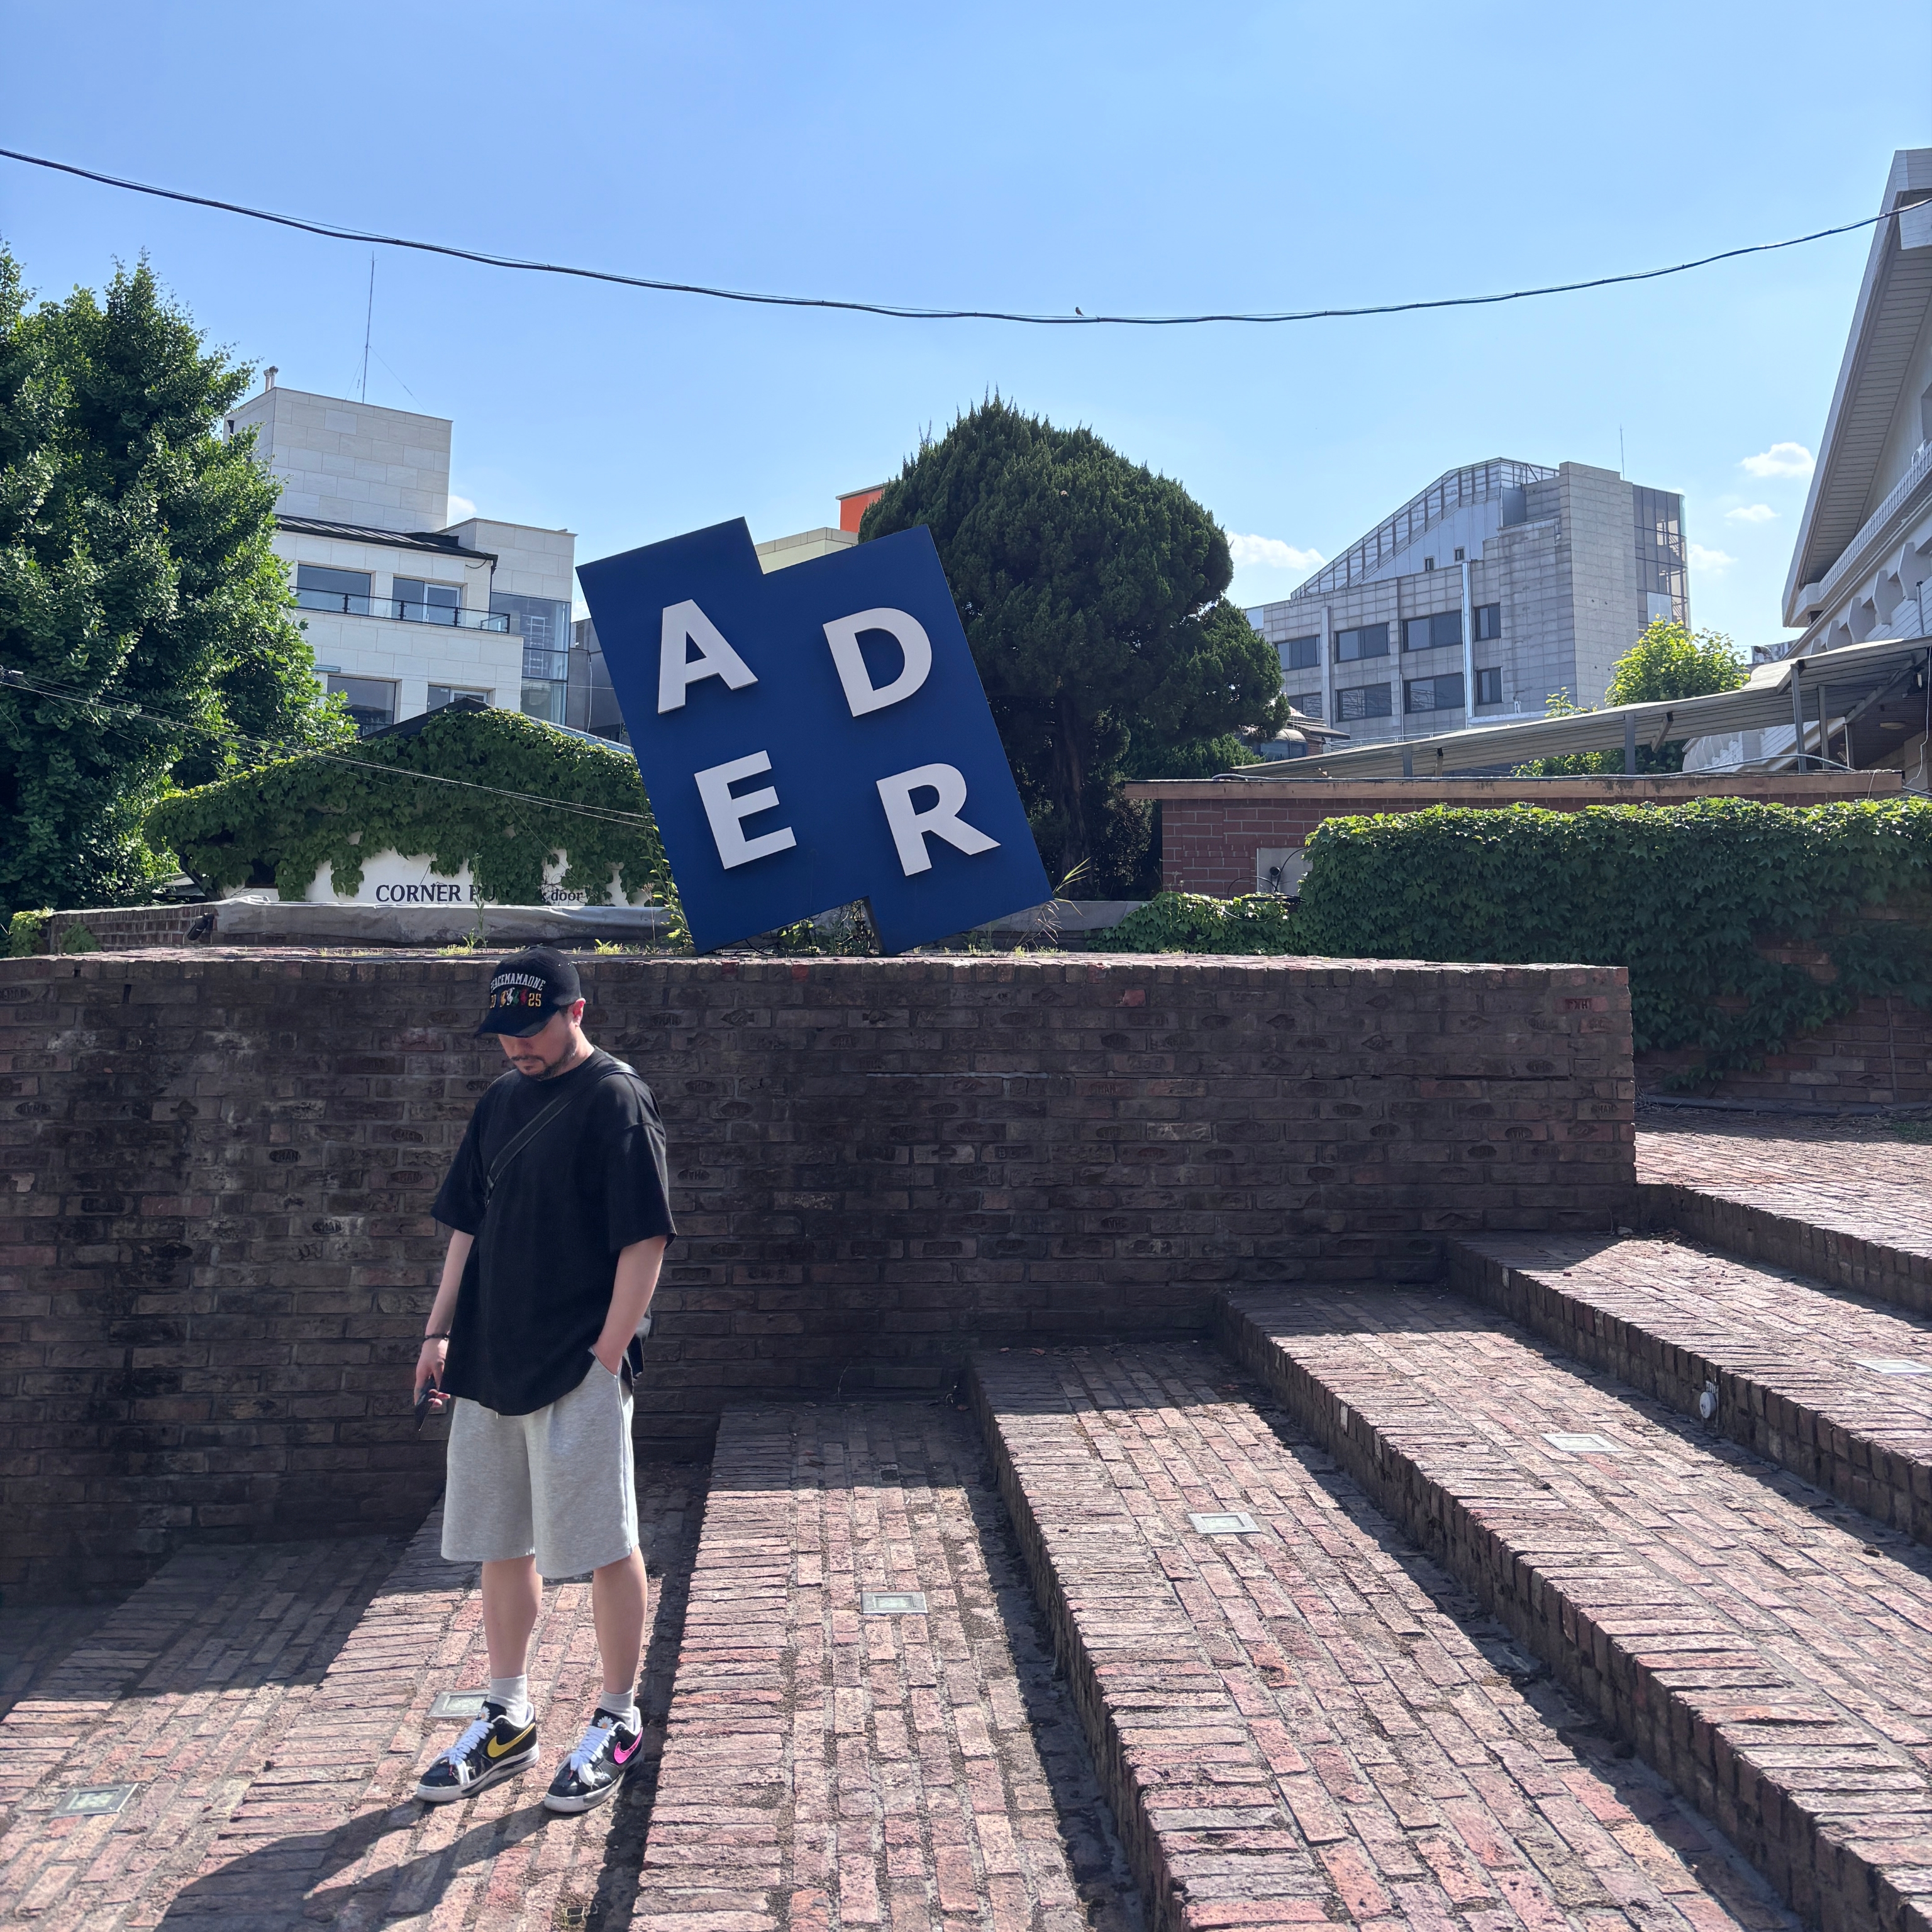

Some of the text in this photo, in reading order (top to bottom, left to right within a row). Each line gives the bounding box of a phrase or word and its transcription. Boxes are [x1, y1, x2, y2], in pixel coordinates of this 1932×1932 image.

[375, 884, 462, 902] CORNER
[551, 889, 584, 901] door
[528, 992, 541, 1007] 25
